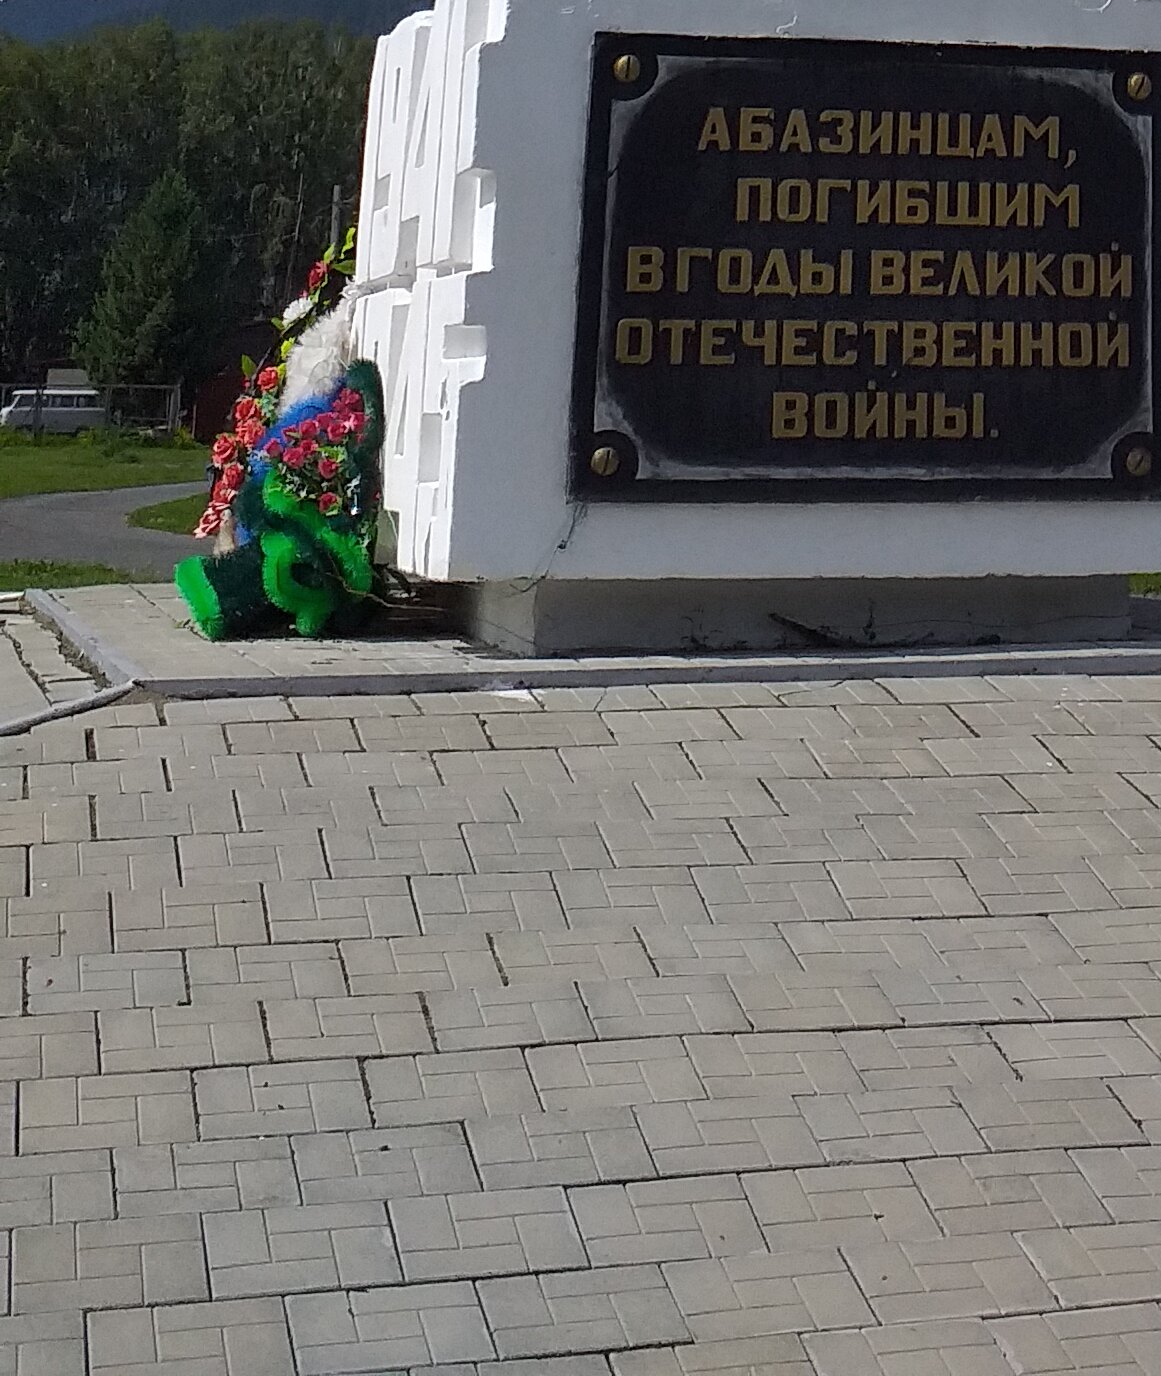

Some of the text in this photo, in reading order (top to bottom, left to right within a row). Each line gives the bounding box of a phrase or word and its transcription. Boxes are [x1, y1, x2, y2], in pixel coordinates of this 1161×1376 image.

[698, 106, 1077, 169] АБАЗИНЦАМ,
[735, 176, 1081, 228] ПОГИБШИМ
[626, 241, 1133, 298] В ГОДЫ ВЕЛИКОЙ
[614, 310, 1131, 368] ОТЕЧЕСТВЕННОЙ
[771, 379, 1000, 439] ВОЙНЫ.
